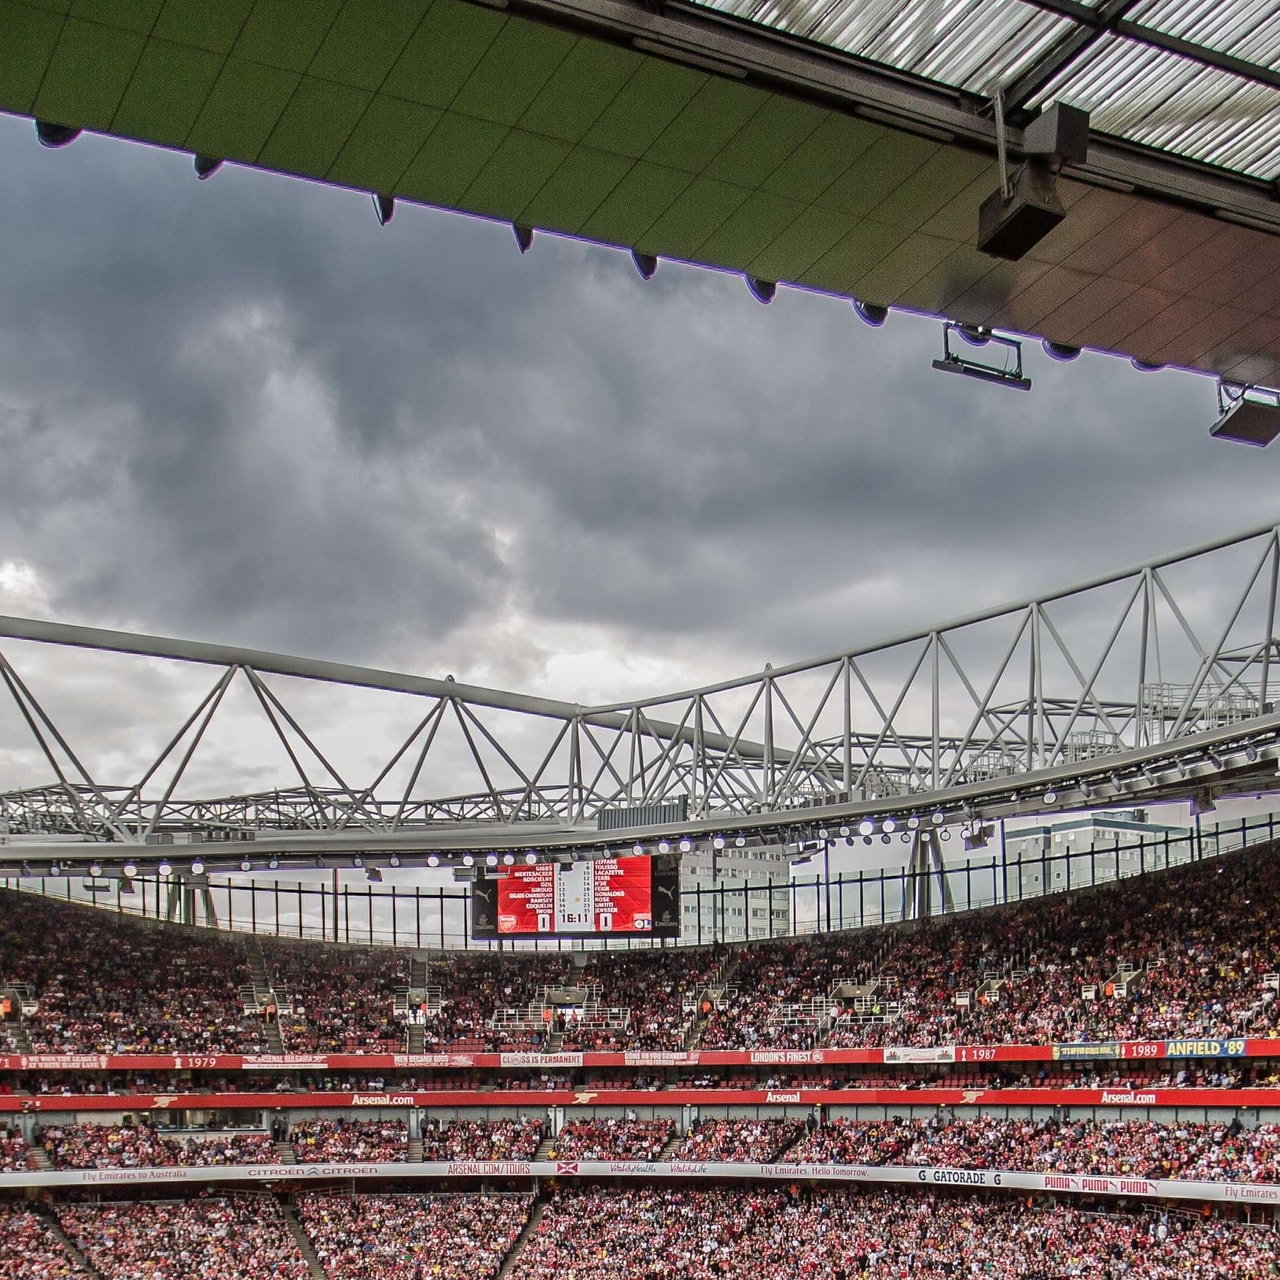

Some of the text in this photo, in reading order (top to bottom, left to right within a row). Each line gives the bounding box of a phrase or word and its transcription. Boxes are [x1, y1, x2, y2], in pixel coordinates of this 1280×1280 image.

[562, 914, 588, 922] 16:11
[1132, 1045, 1157, 1057] 1989
[1167, 1041, 1220, 1055] ANFIELD
[751, 1052, 811, 1062] LONDON'S FINEST
[972, 1049, 996, 1060] 1987
[188, 1058, 216, 1068] 1979
[352, 1094, 414, 1105] Arsenal.com
[766, 1092, 800, 1103] Arsenal
[1101, 1091, 1156, 1104] Arsenal.com
[447, 1164, 530, 1175] ARSENAL.COM/TOURS
[761, 1166, 773, 1176] Fly
[812, 1166, 830, 1175] Hello
[832, 1167, 869, 1177] Tomorrow.
[83, 1170, 187, 1182] Fly Emirates to Australia
[918, 1170, 926, 1181] G
[933, 1171, 986, 1184] GATORADE
[993, 1174, 1001, 1186] G
[1045, 1177, 1148, 1194] PUMA PUMA PUMA
[1225, 1186, 1238, 1199] Fly
[1241, 1187, 1278, 1200] Emirates
